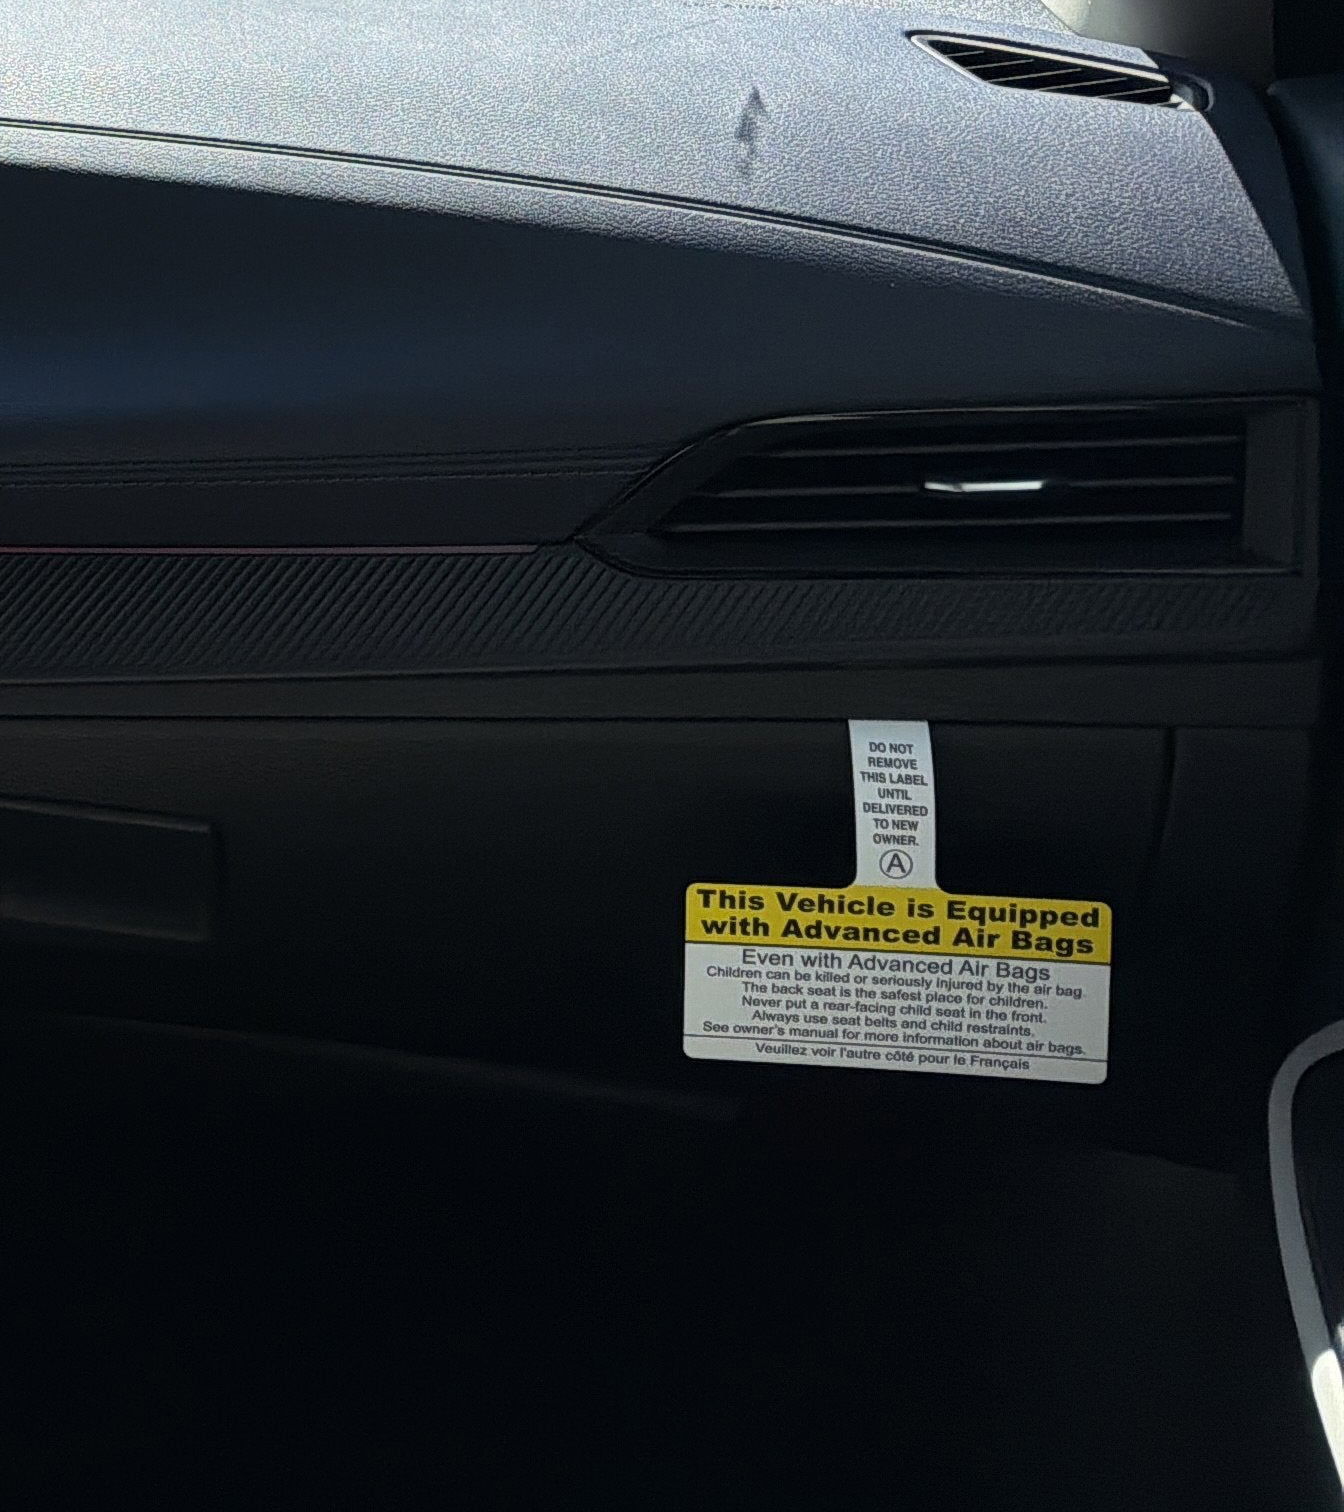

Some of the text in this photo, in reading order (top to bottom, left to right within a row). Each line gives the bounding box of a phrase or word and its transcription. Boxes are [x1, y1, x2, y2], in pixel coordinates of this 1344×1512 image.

[869, 742, 913, 754] DO NOT
[868, 757, 918, 770] REMOVE
[860, 771, 928, 786] THIS LABEL
[878, 787, 912, 800] UNTIL
[863, 802, 928, 816] DELIVERED
[873, 818, 918, 831] TO NEW
[873, 833, 919, 846] OWNER.
[697, 889, 1099, 929] This Vehicle is Equipped
[701, 917, 1093, 957] with Advanced Air Bags
[743, 949, 1050, 983] Even with Advanced Air Bags
[707, 966, 762, 978] Children
[766, 972, 791, 980] can
[795, 970, 811, 982] be
[816, 971, 850, 983] killed
[854, 975, 868, 985] or
[872, 974, 932, 989] seriously
[936, 977, 982, 992] injured
[987, 980, 1004, 994] by
[1008, 982, 1030, 993] the
[1033, 984, 1050, 995] air
[742, 981, 1048, 1009] The back seat is the safest place for children.
[742, 995, 1047, 1024] Never put a rear-facing child seat in the front.
[752, 1010, 1035, 1037] Always use seat belts and child restraints.
[703, 1021, 1086, 1056] See owner's manual for more information about air bags.
[755, 1042, 1030, 1071] Veuillez voir l'autre côté pour le Français
